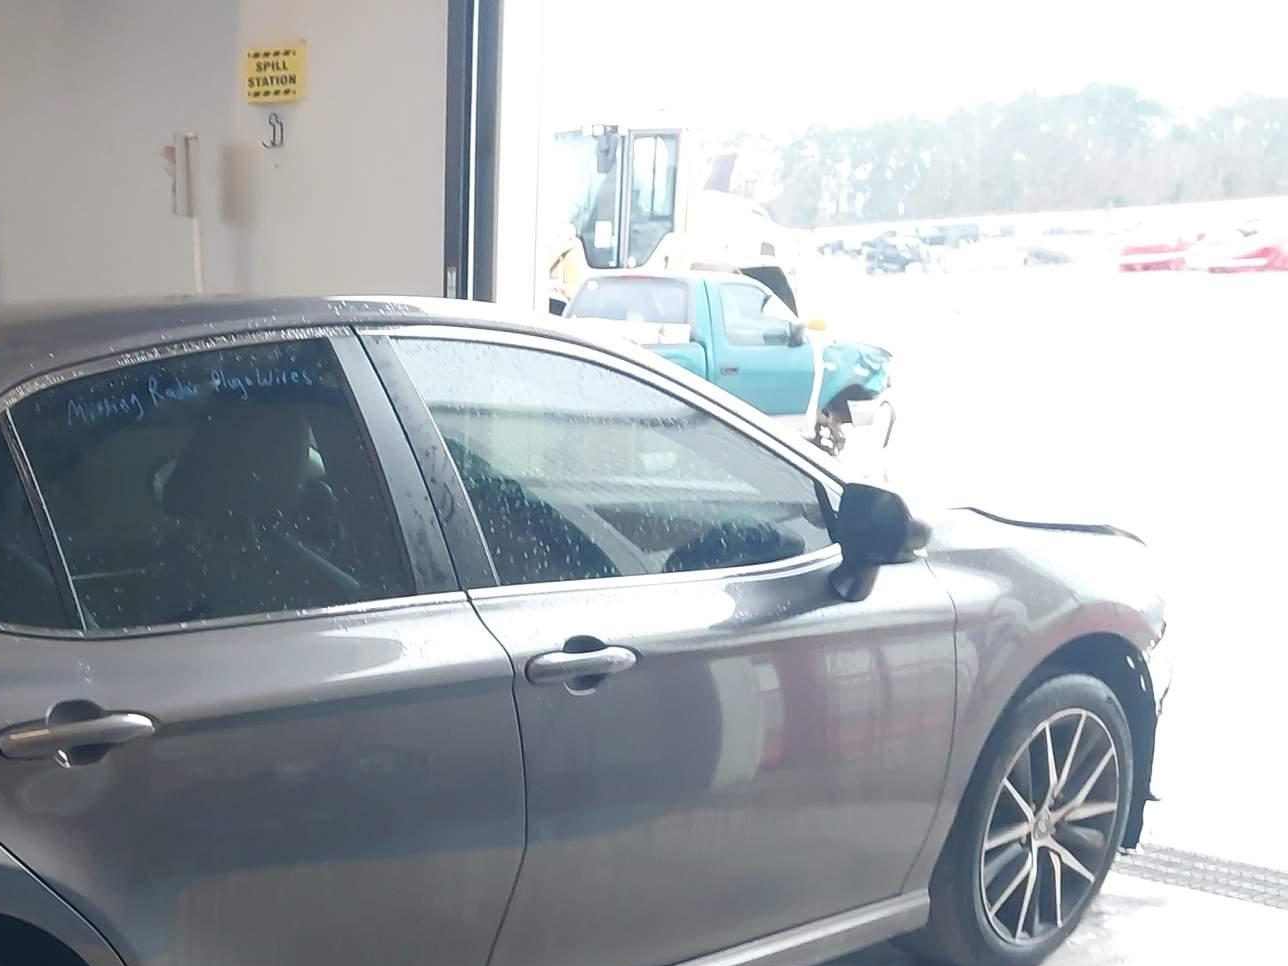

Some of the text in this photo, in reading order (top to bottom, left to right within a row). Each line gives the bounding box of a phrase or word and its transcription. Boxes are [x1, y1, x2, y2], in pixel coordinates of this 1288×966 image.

[255, 60, 288, 72] SPILL
[248, 74, 296, 88] STATION
[67, 391, 144, 425] Missing
